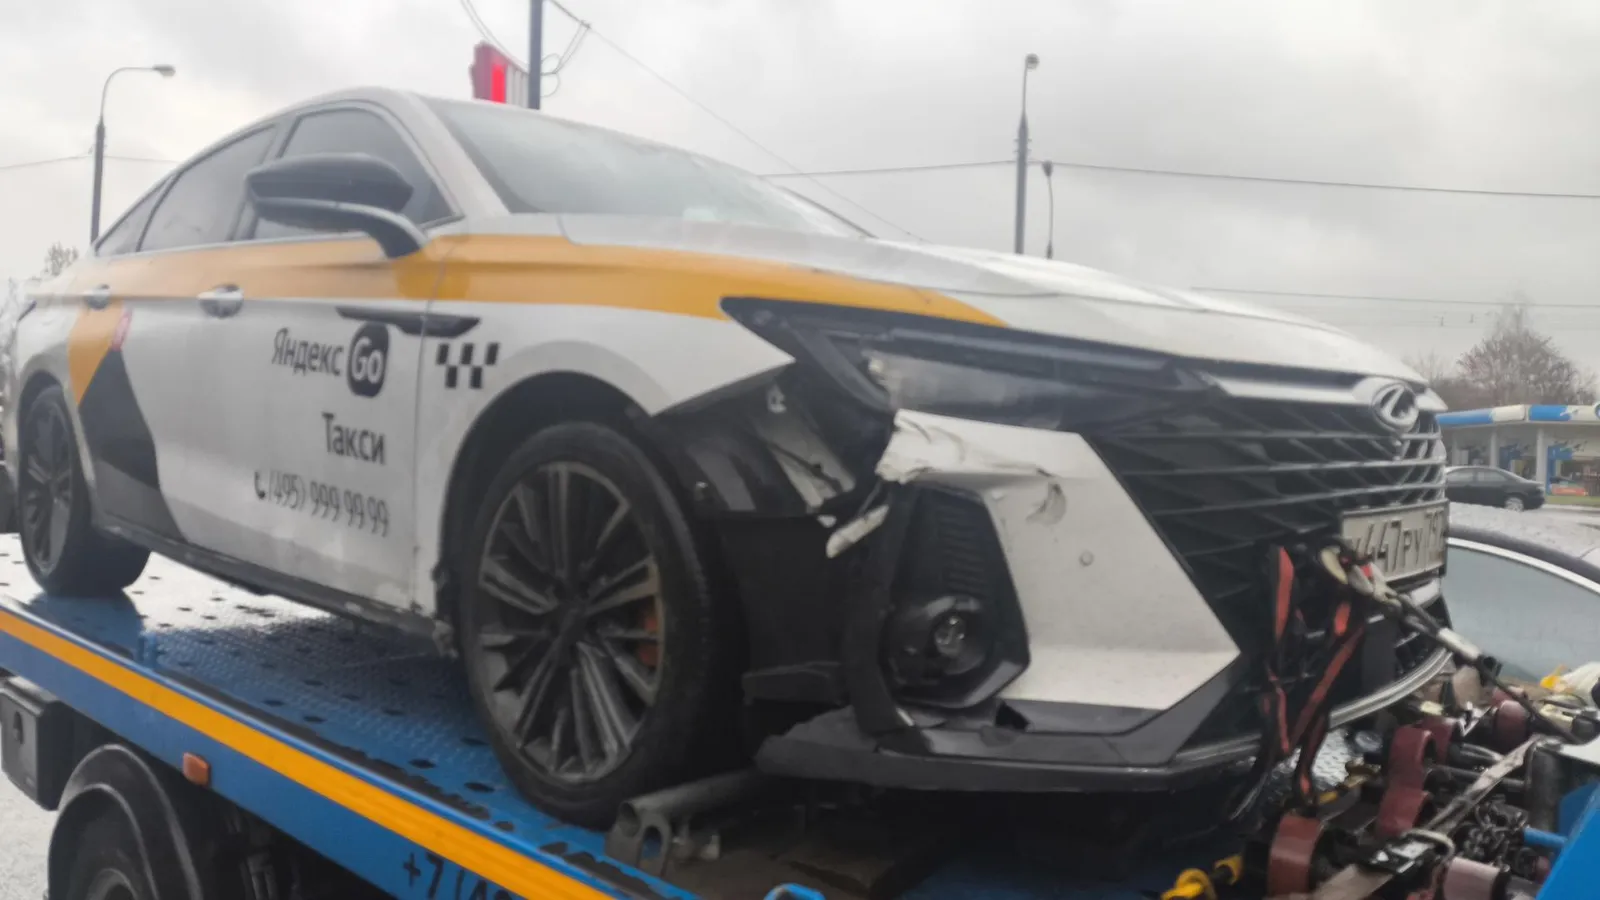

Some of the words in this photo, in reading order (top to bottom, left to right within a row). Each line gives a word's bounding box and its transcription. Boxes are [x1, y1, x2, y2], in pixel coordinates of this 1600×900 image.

[272, 327, 344, 376] Яндекс
[351, 337, 383, 384] Go
[322, 412, 386, 465] Такси
[268, 470, 307, 511] (495)
[310, 481, 341, 522] 999
[344, 493, 366, 529] 99
[368, 497, 391, 538] 99
